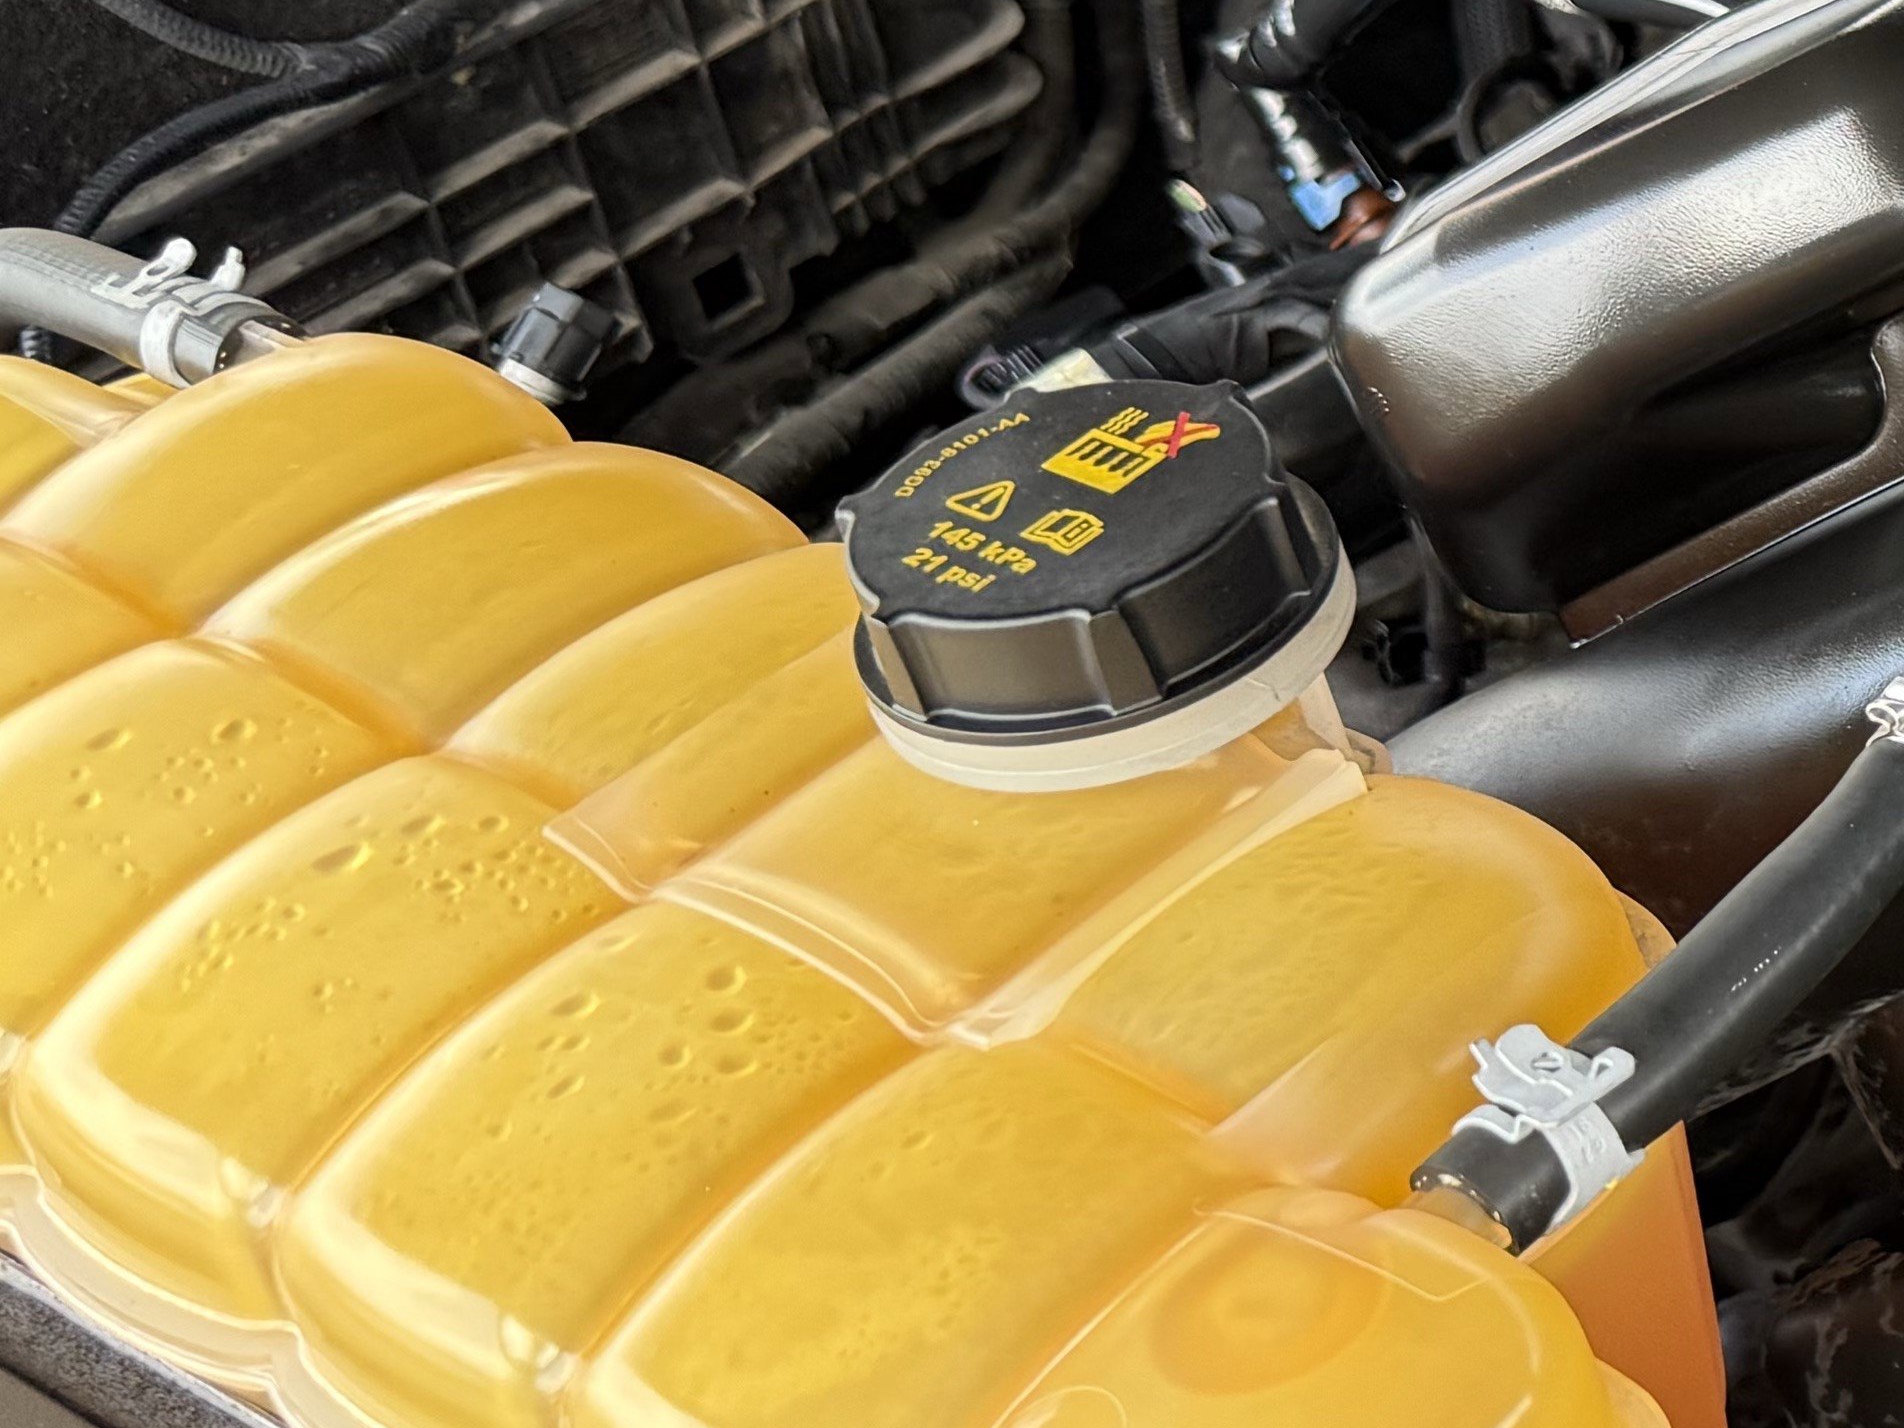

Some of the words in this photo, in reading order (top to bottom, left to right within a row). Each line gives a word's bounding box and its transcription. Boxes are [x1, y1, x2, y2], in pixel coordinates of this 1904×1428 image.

[901, 547, 949, 573] 21
[935, 565, 997, 593] psi
[928, 521, 987, 551] 145
[977, 540, 1037, 575] kPa
